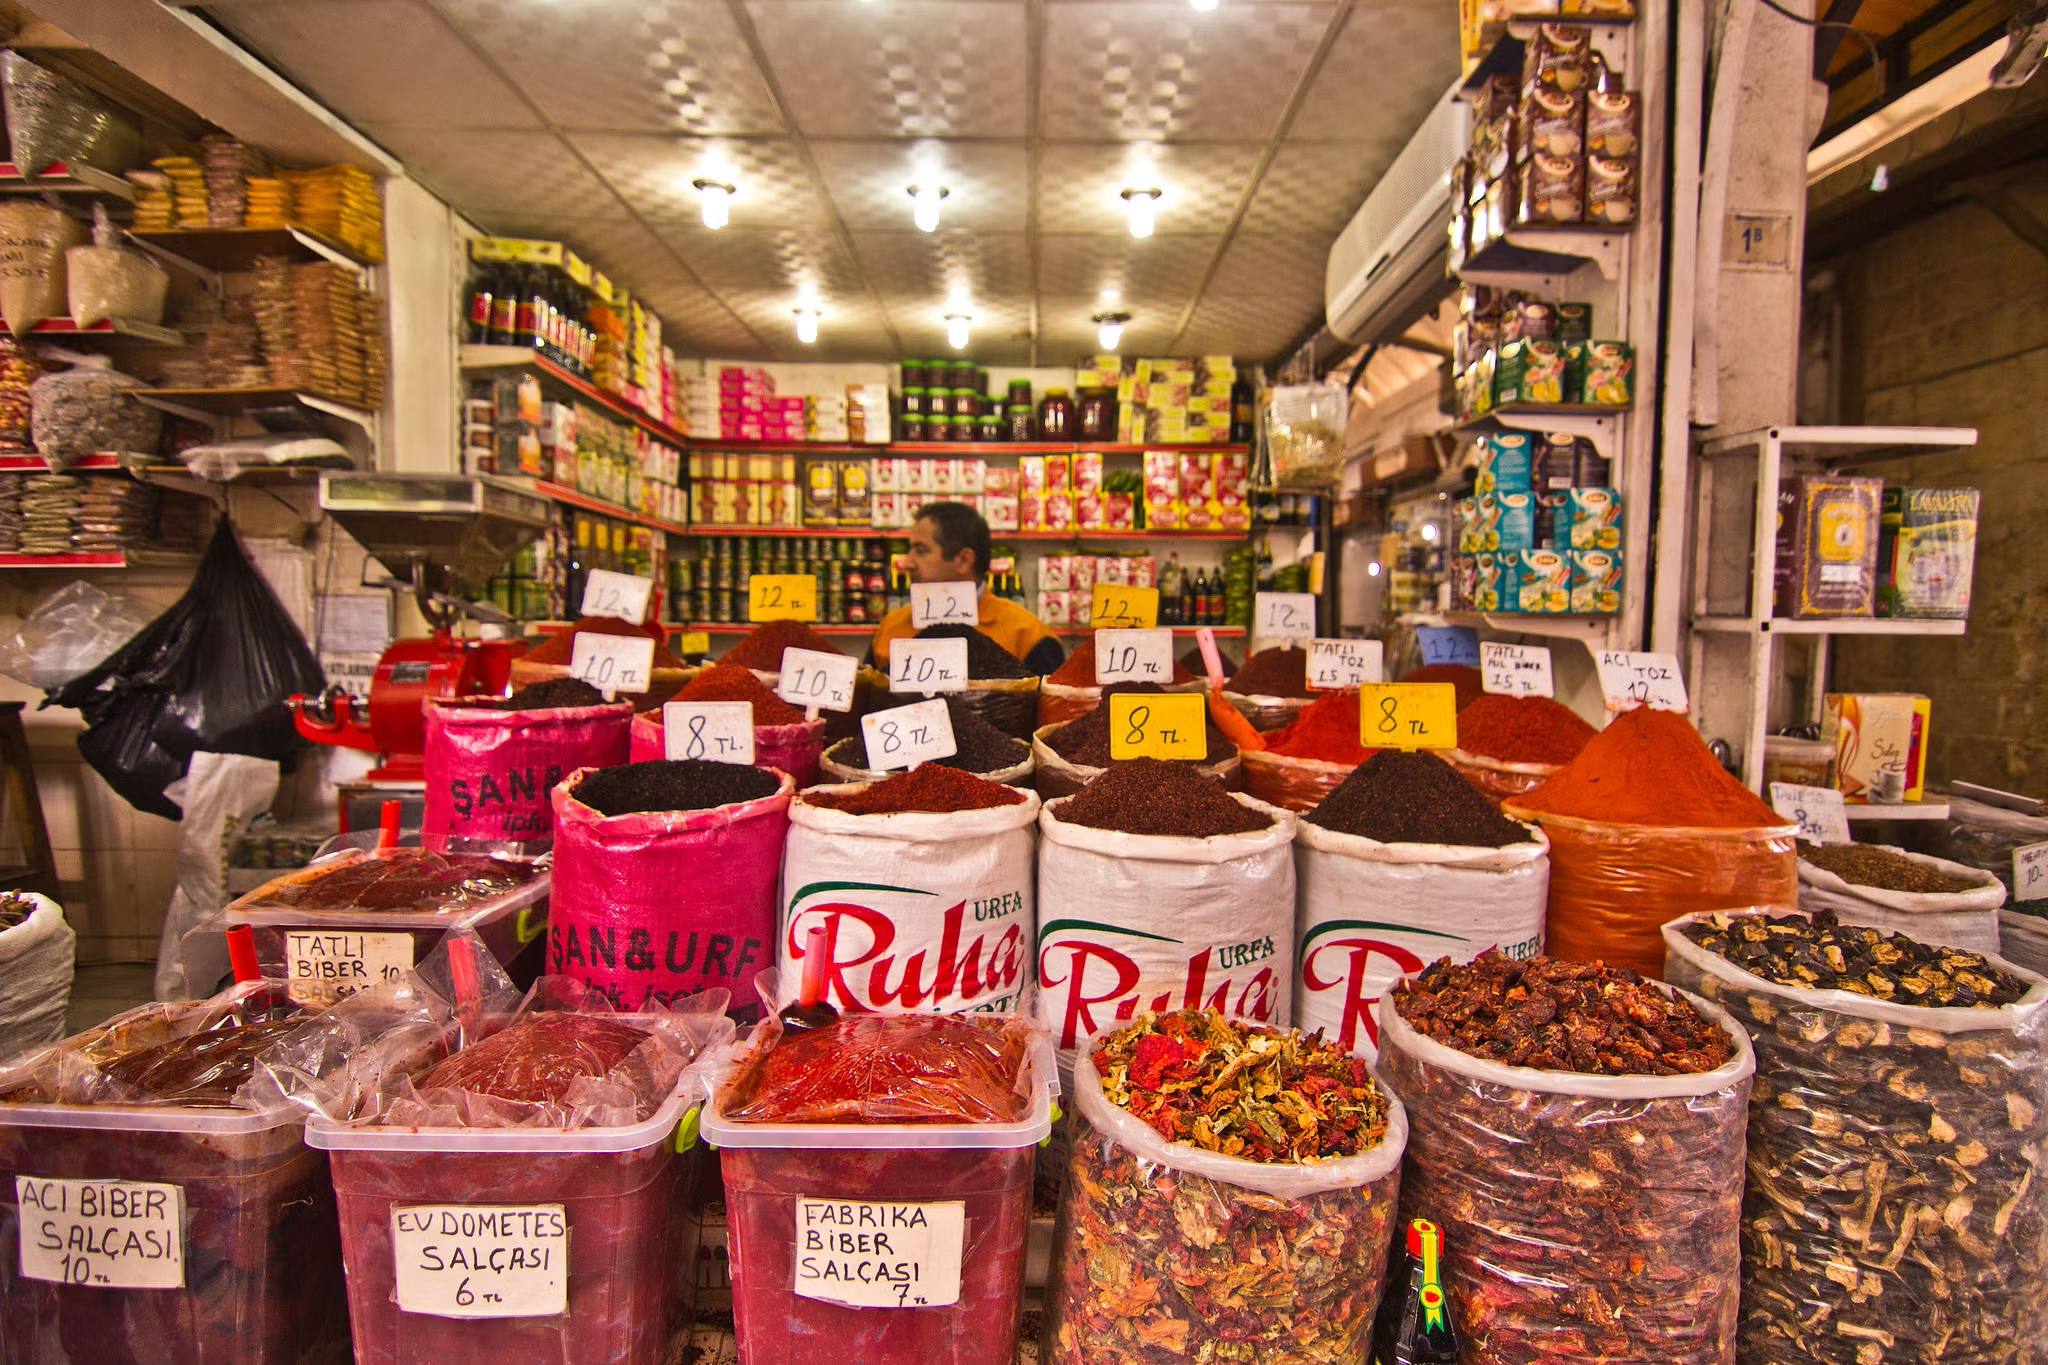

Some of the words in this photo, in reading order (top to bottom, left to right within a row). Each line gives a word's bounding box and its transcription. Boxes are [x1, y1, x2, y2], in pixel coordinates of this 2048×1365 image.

[591, 587, 621, 612] 12
[757, 585, 784, 609] 12
[919, 596, 961, 621] 12
[1093, 598, 1130, 620] 12
[1267, 603, 1297, 628] 12
[1102, 645, 1138, 675] 10
[1313, 642, 1355, 656] TATLI
[1430, 636, 1461, 659] 12
[1485, 645, 1525, 659] TATLI
[1604, 652, 1631, 667] ACI
[582, 655, 615, 684] 10
[787, 666, 828, 697] 10
[895, 654, 936, 683] 10
[1315, 669, 1338, 683] 15
[1491, 673, 1513, 689] 15
[1634, 667, 1673, 680] TOZ
[1627, 681, 1653, 704] 12
[1125, 705, 1151, 746] 8
[1378, 696, 1398, 733] 8
[1408, 720, 1430, 736] TL
[686, 715, 707, 761] 8
[880, 721, 901, 754] 8
[974, 891, 1023, 922] URFA
[290, 935, 365, 959] TATLI
[787, 899, 1025, 1013] Ruha
[1218, 935, 1276, 970] URFA
[22, 1180, 67, 1213] ACI
[80, 1185, 168, 1220] BİBER
[397, 1212, 433, 1233] EV
[440, 1211, 565, 1238] DOMETES
[803, 1203, 929, 1229] FABRIKA
[805, 1229, 895, 1256] BİBER
[60, 1253, 91, 1285] 10
[419, 1245, 551, 1275] SALÇASI
[800, 1256, 920, 1285] SALÇASI
[456, 1276, 476, 1307] 6
[892, 1283, 911, 1308] 7
